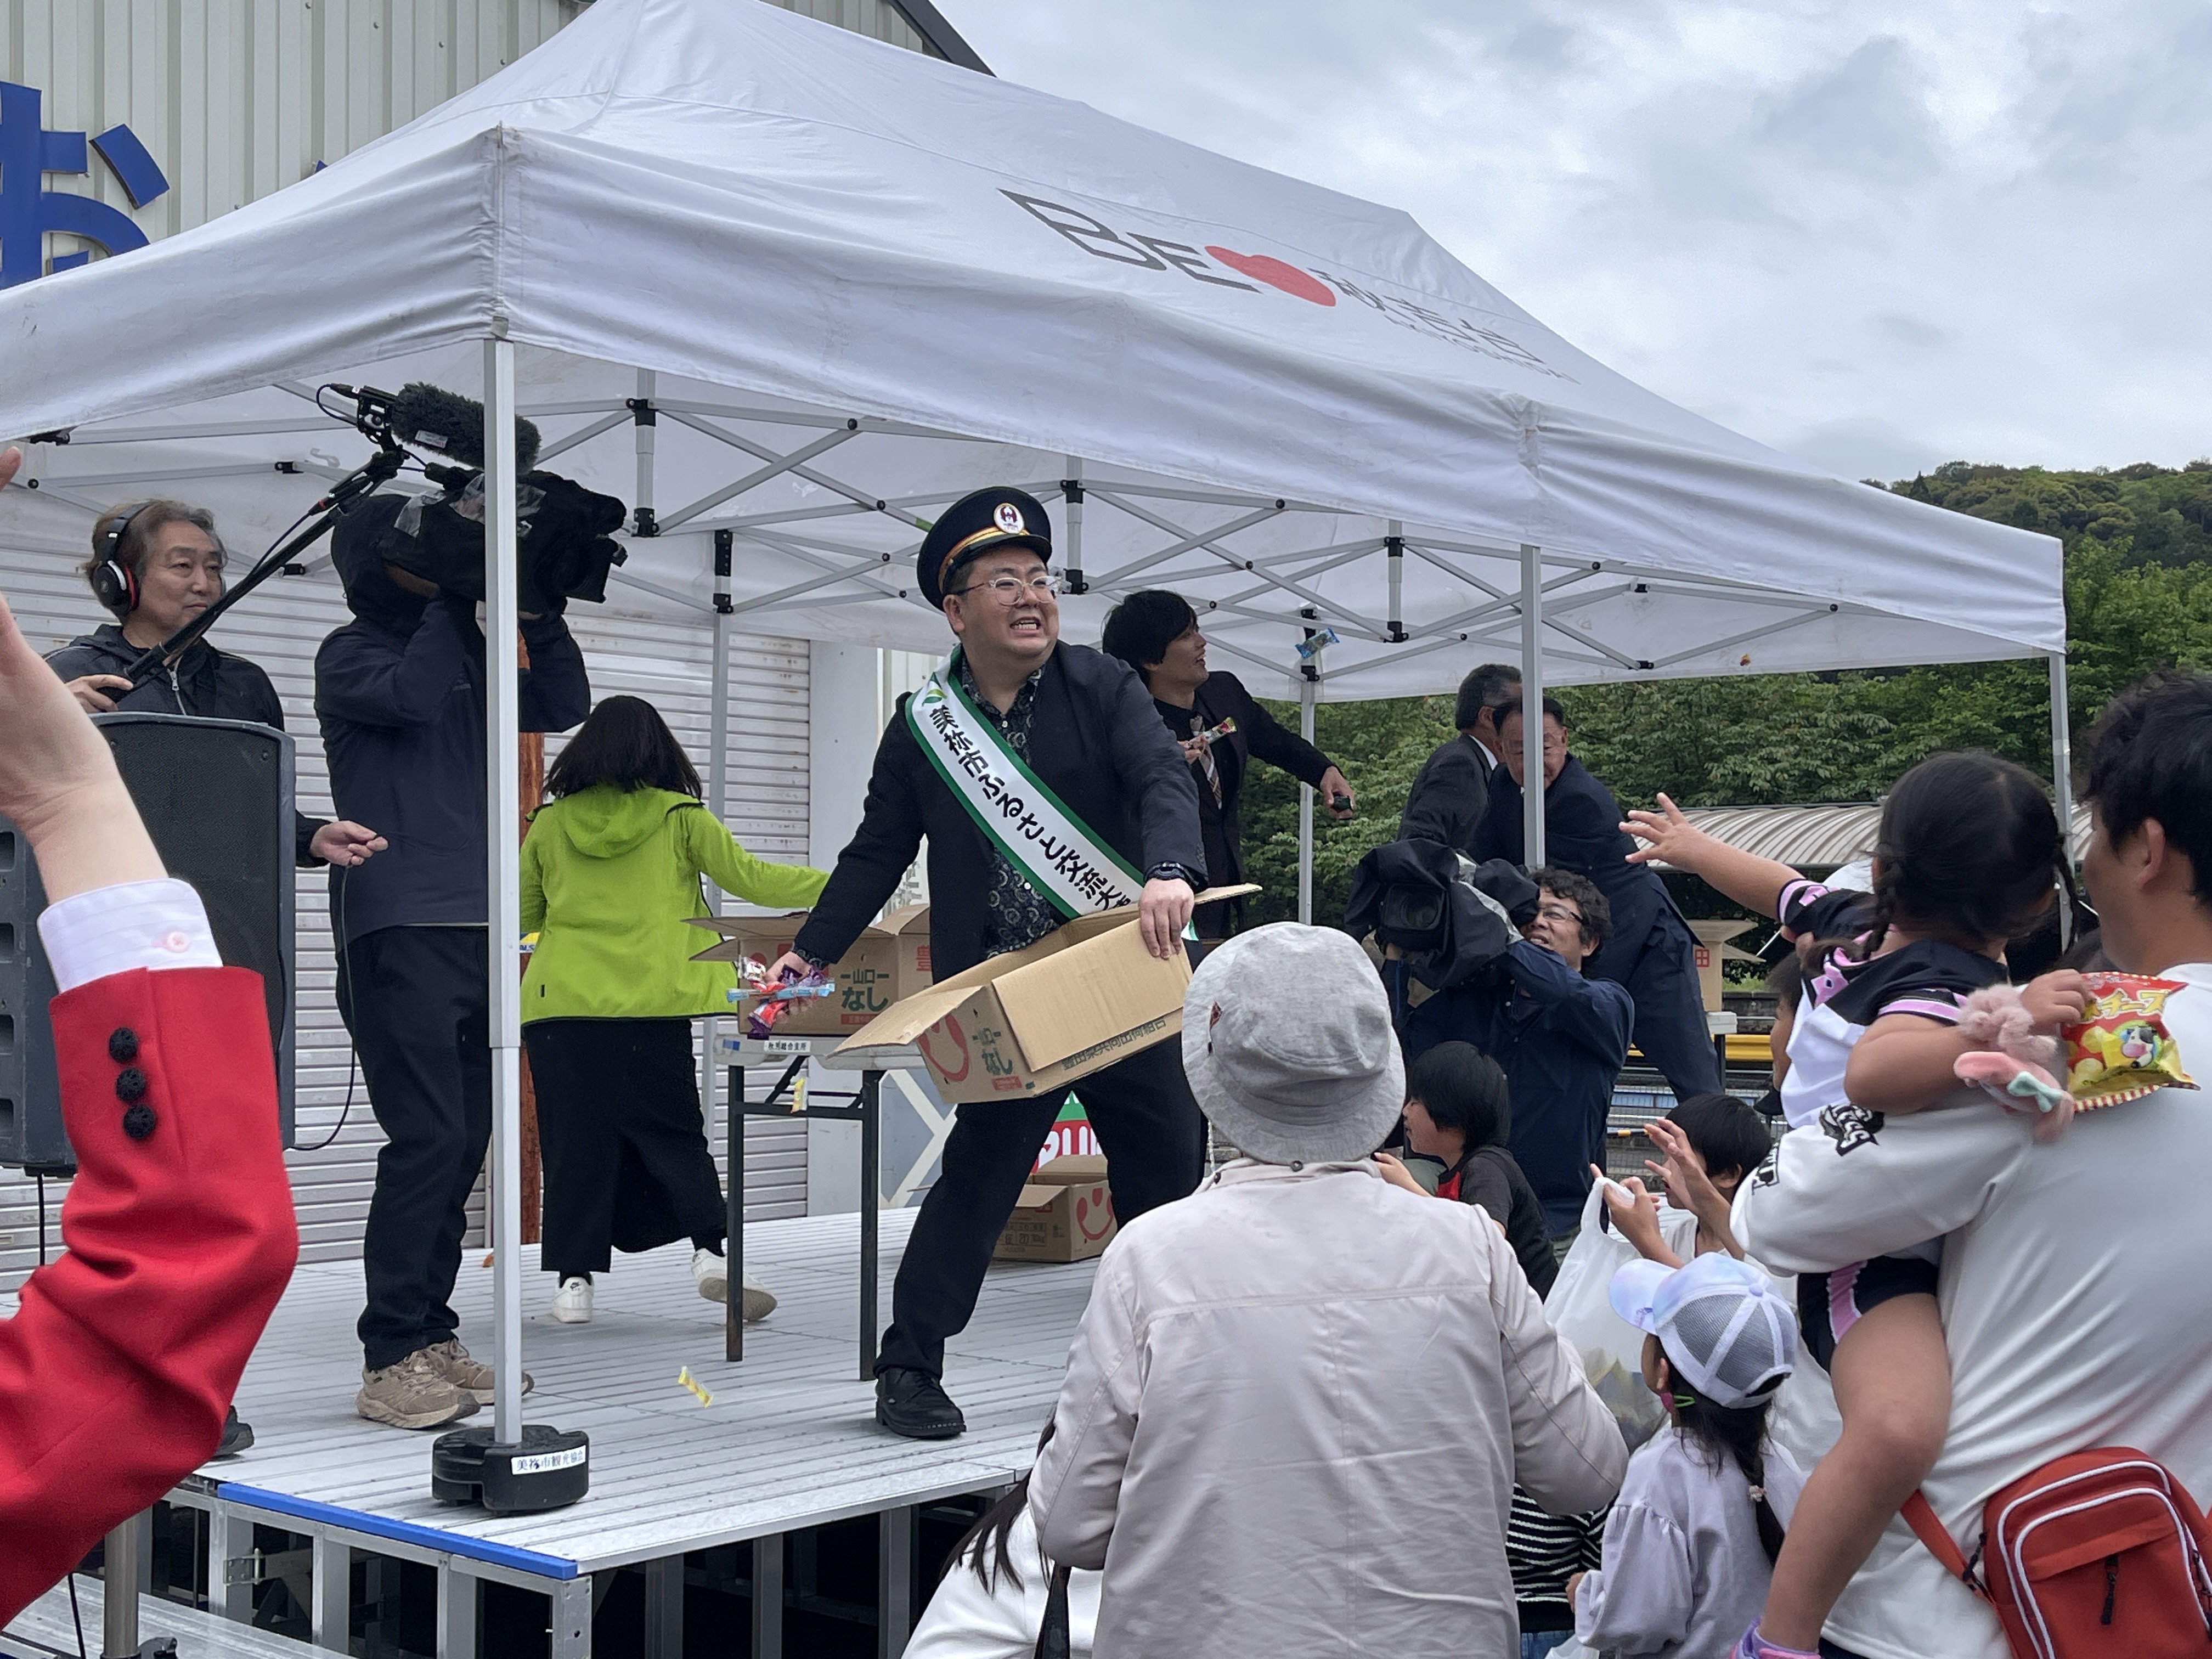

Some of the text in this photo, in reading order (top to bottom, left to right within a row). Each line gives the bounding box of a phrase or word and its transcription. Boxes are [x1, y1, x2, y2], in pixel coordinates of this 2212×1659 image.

[998, 188, 1263, 294] BE
[1307, 267, 1545, 364] 秋吉台
[842, 986, 889, 1012] なし
